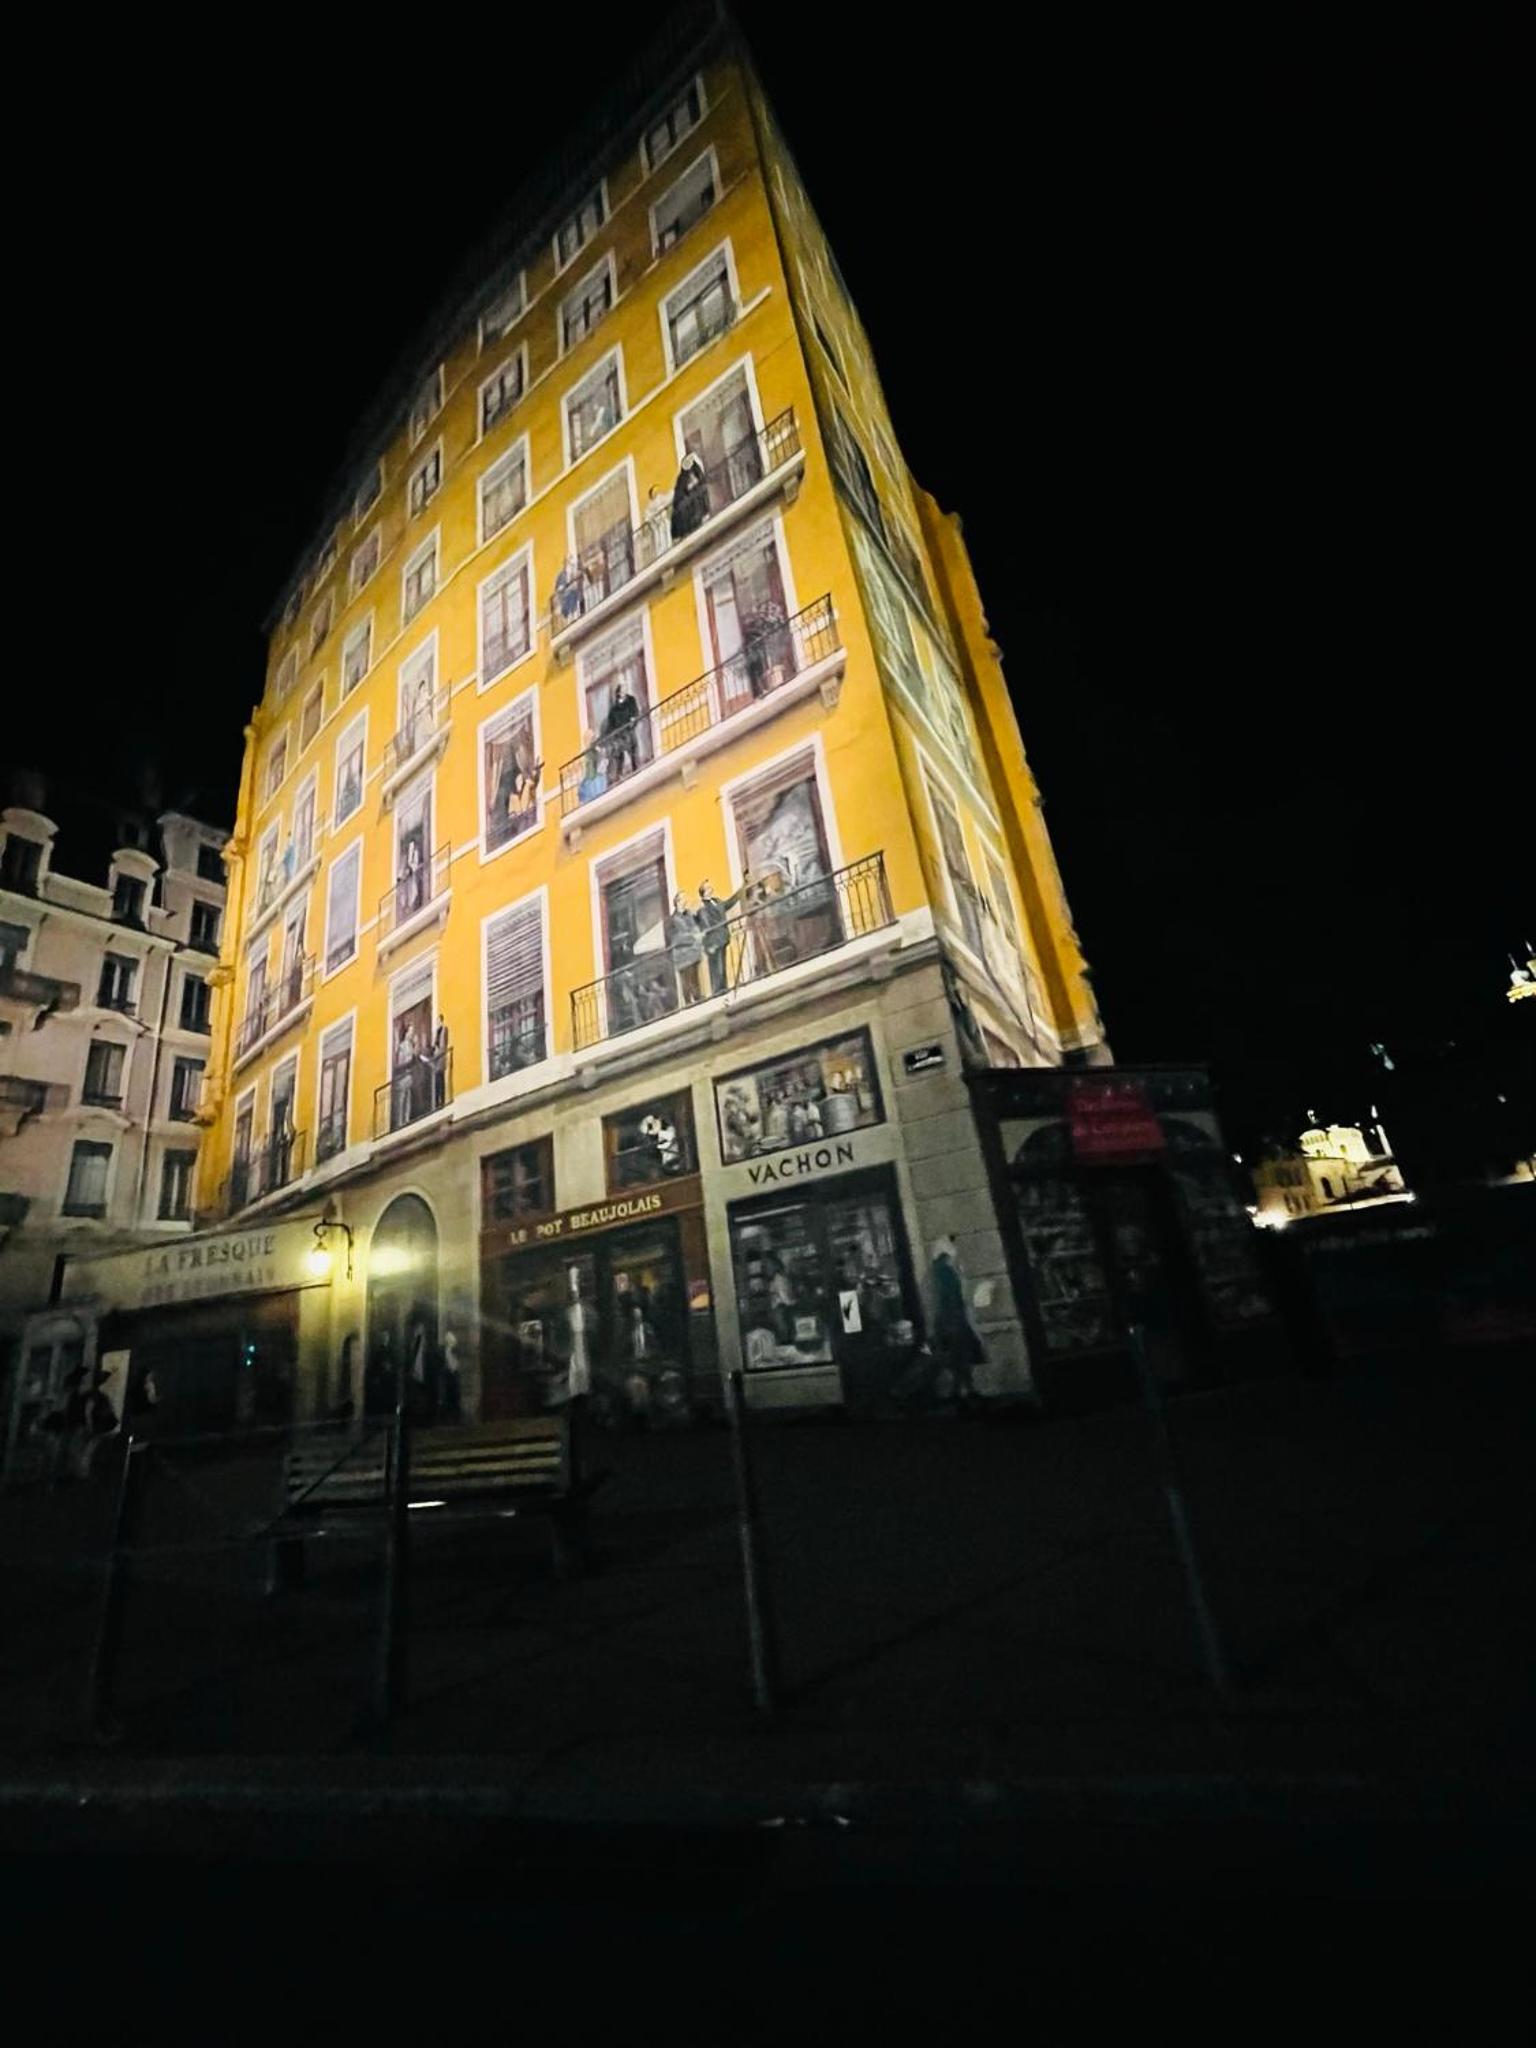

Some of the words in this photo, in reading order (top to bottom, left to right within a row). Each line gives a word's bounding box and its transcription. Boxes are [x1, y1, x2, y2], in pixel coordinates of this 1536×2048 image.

[748, 1142, 854, 1185] VACHON
[510, 1229, 528, 1245] LE
[536, 1218, 563, 1239] POT
[570, 1194, 662, 1230] BEAUJOLAIS
[178, 1233, 277, 1271] FRESQUE
